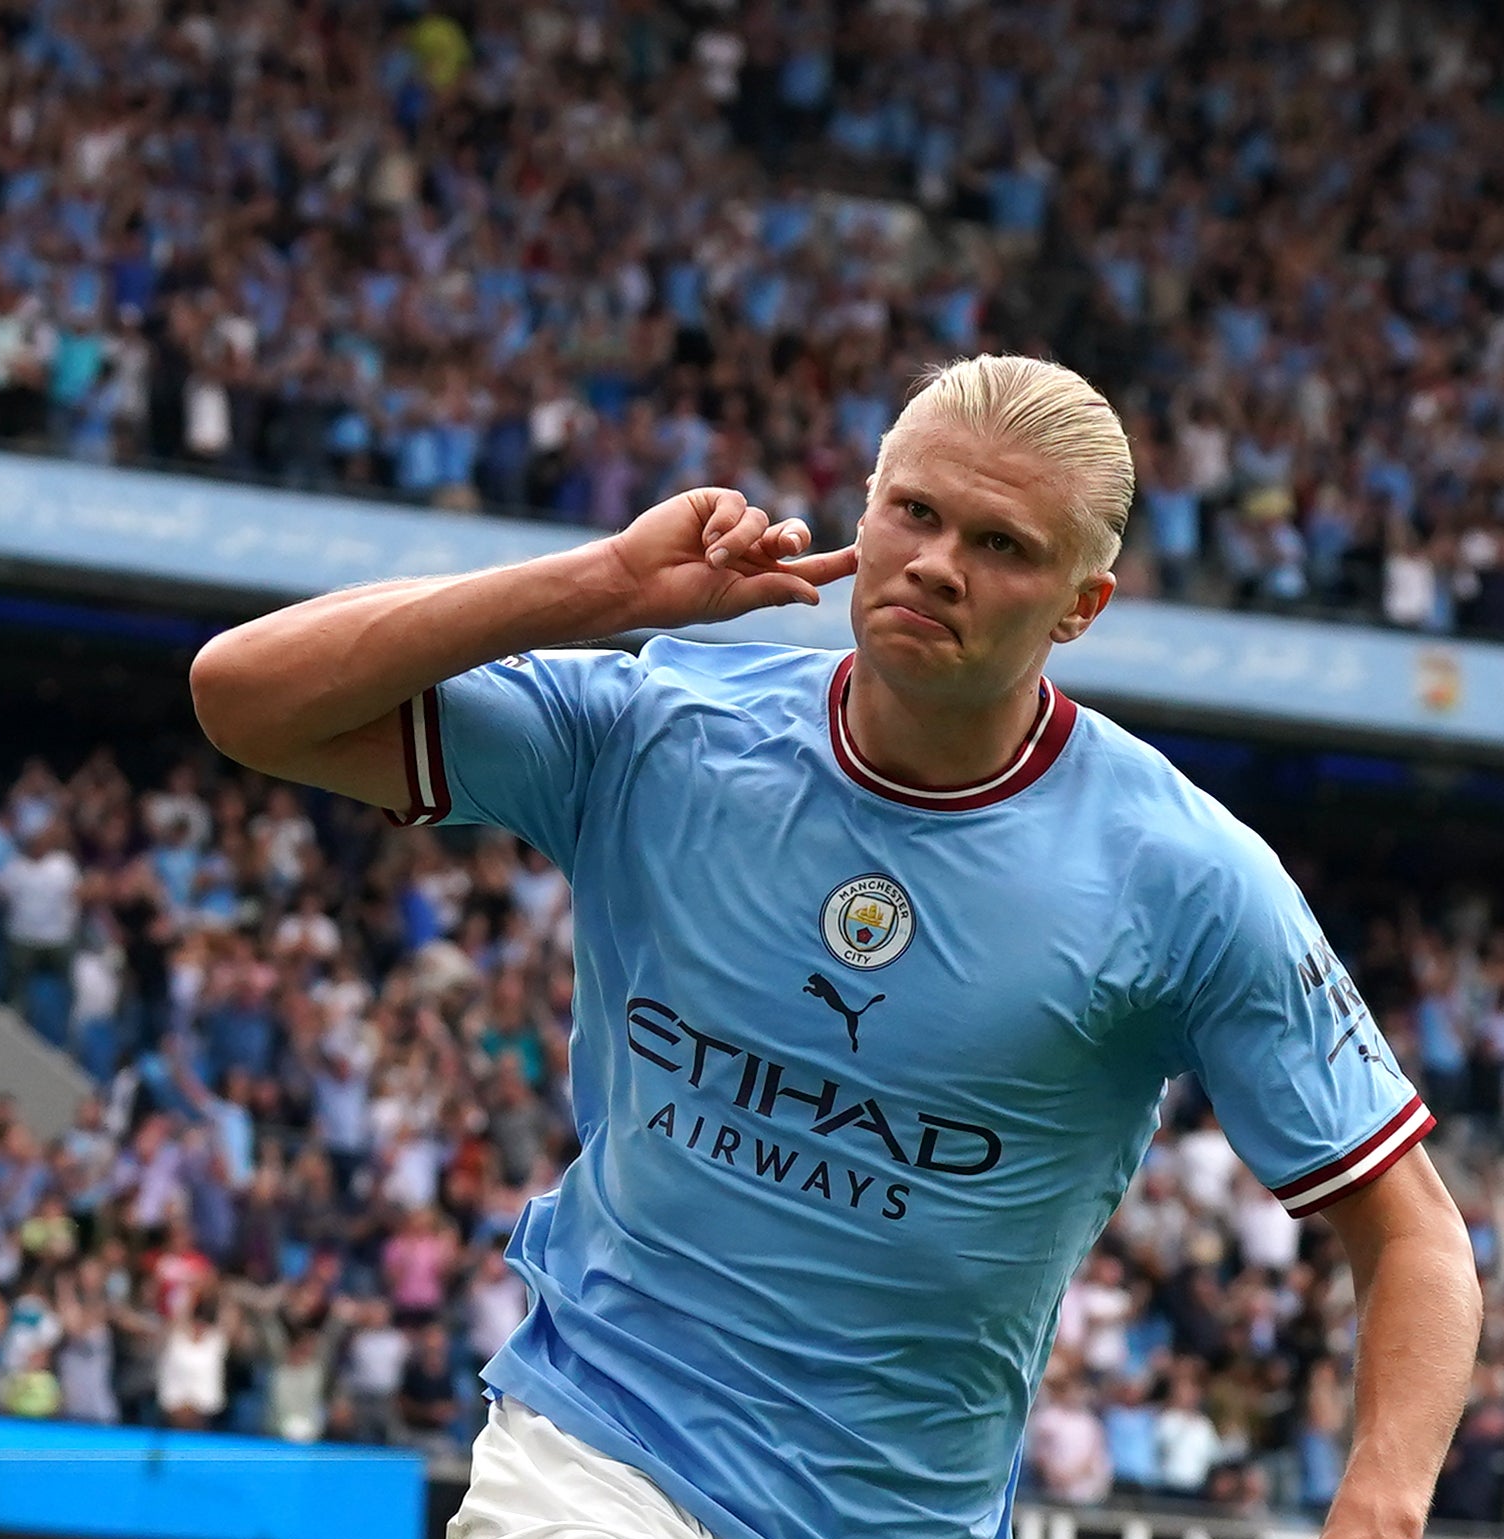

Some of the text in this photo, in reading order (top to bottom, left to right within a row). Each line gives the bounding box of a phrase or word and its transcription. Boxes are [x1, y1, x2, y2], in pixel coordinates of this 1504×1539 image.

[838, 880, 910, 920] MANCHESTER
[843, 949, 872, 965] CITY
[626, 996, 1002, 1177] ETIHAD
[646, 1101, 911, 1221] AIRWAYS
